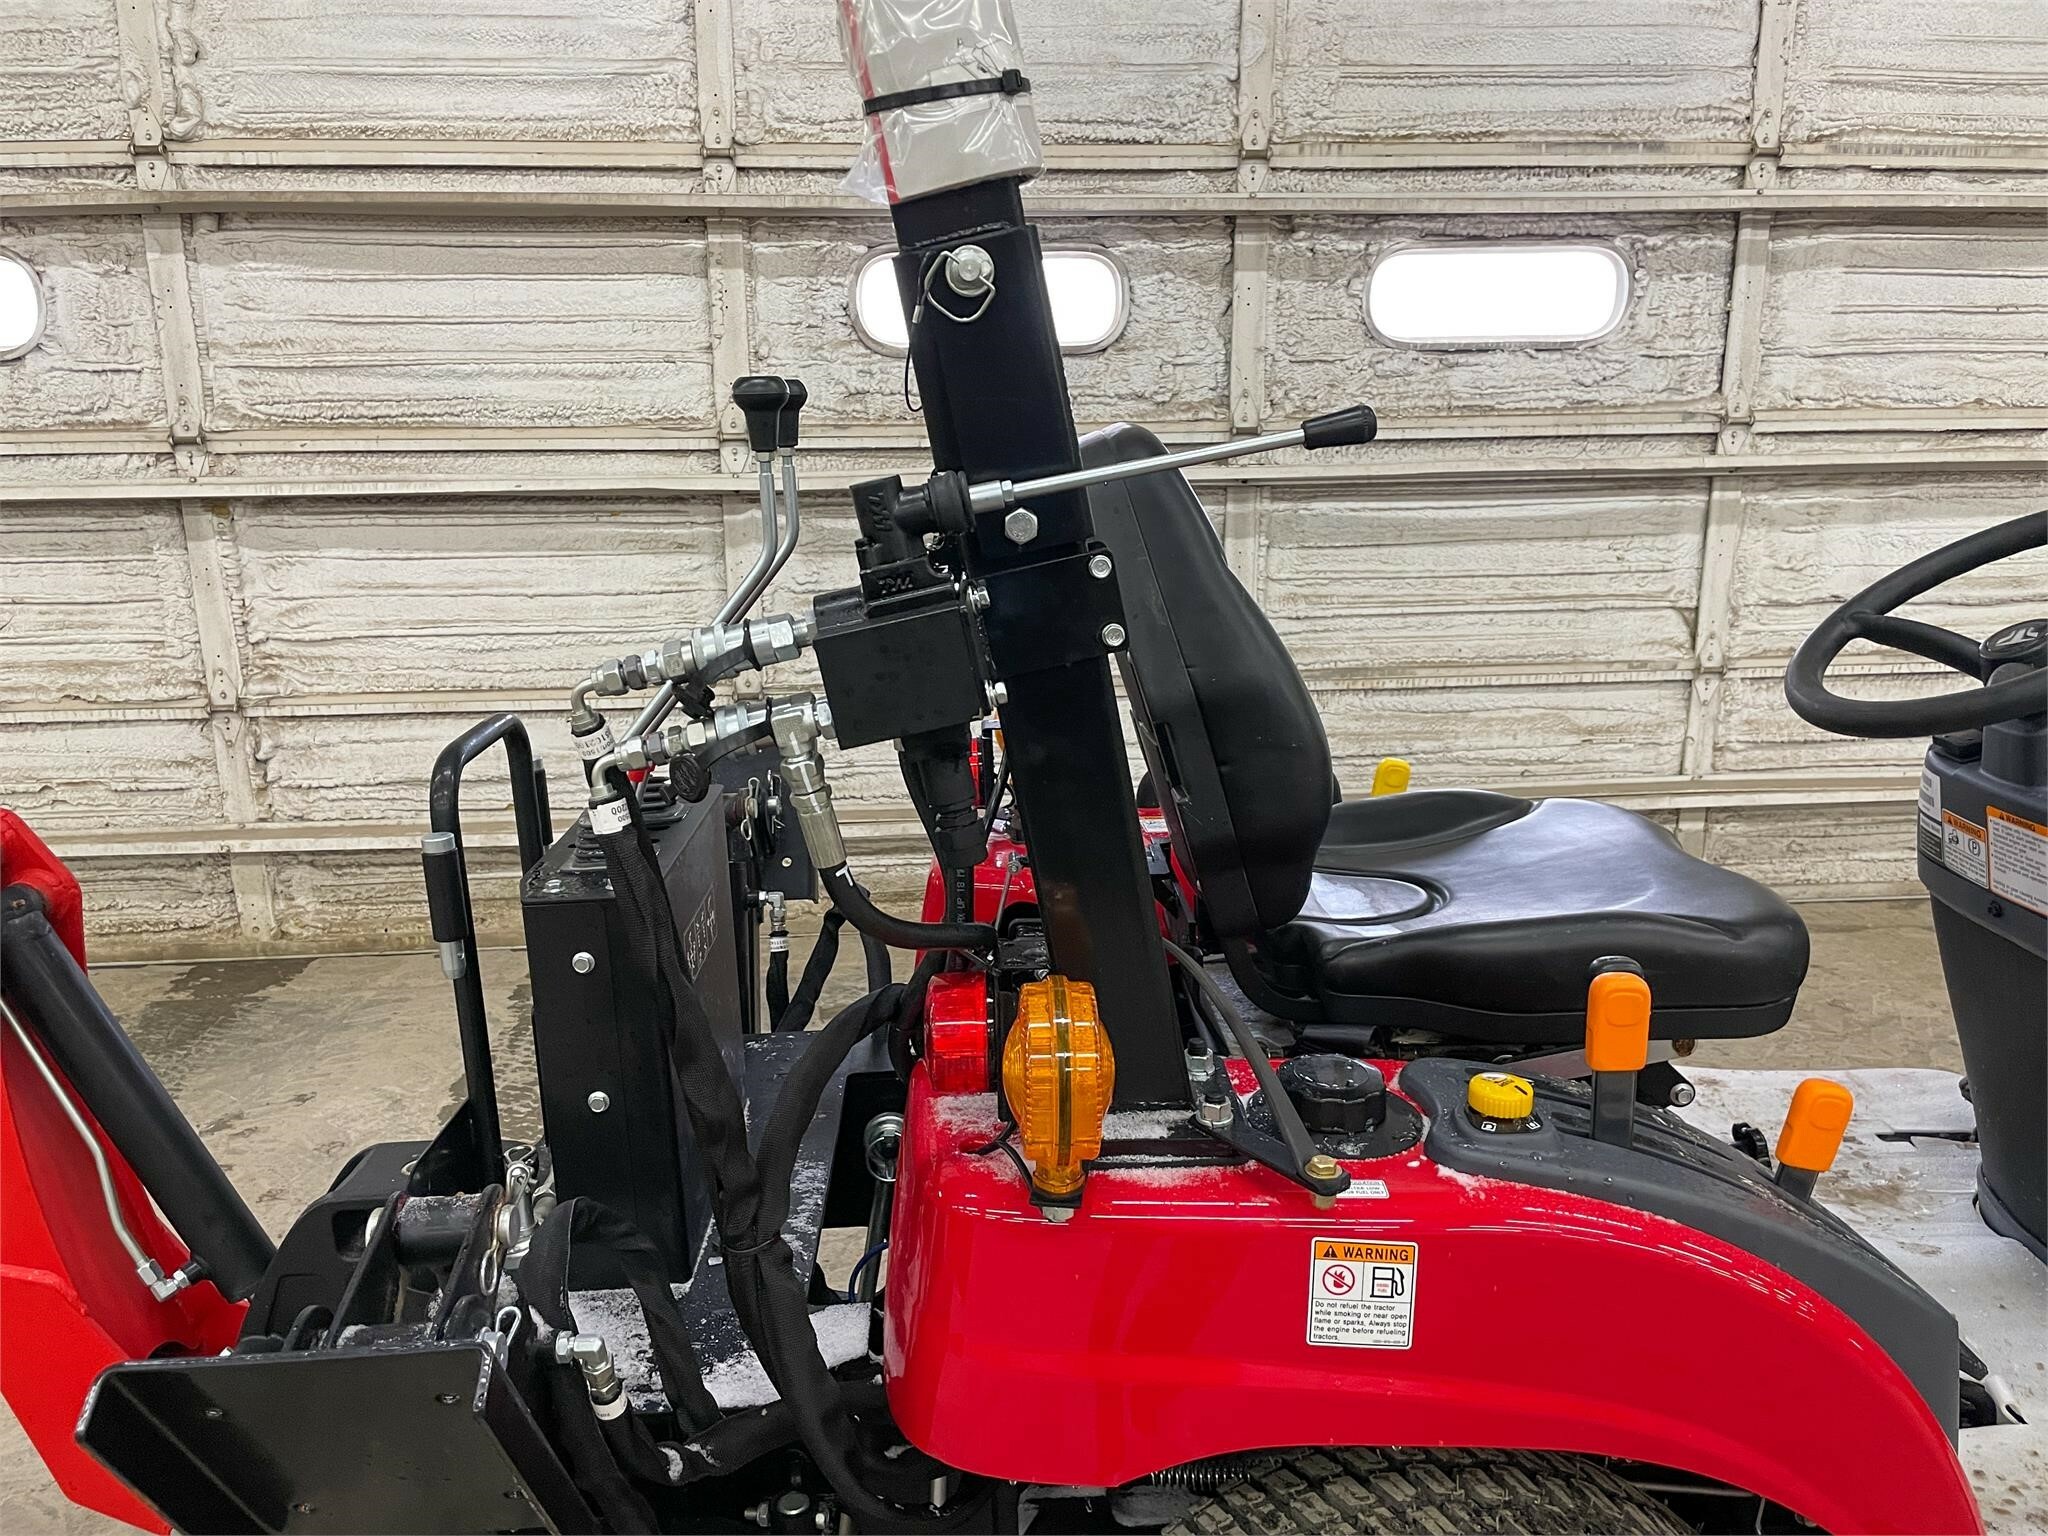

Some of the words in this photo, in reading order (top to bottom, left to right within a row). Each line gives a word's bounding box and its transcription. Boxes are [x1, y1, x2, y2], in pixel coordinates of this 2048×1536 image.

[1343, 1246, 1409, 1261] WARNING
[1334, 1310, 1362, 1318] smoking
[1376, 1328, 1406, 1336] refueling
